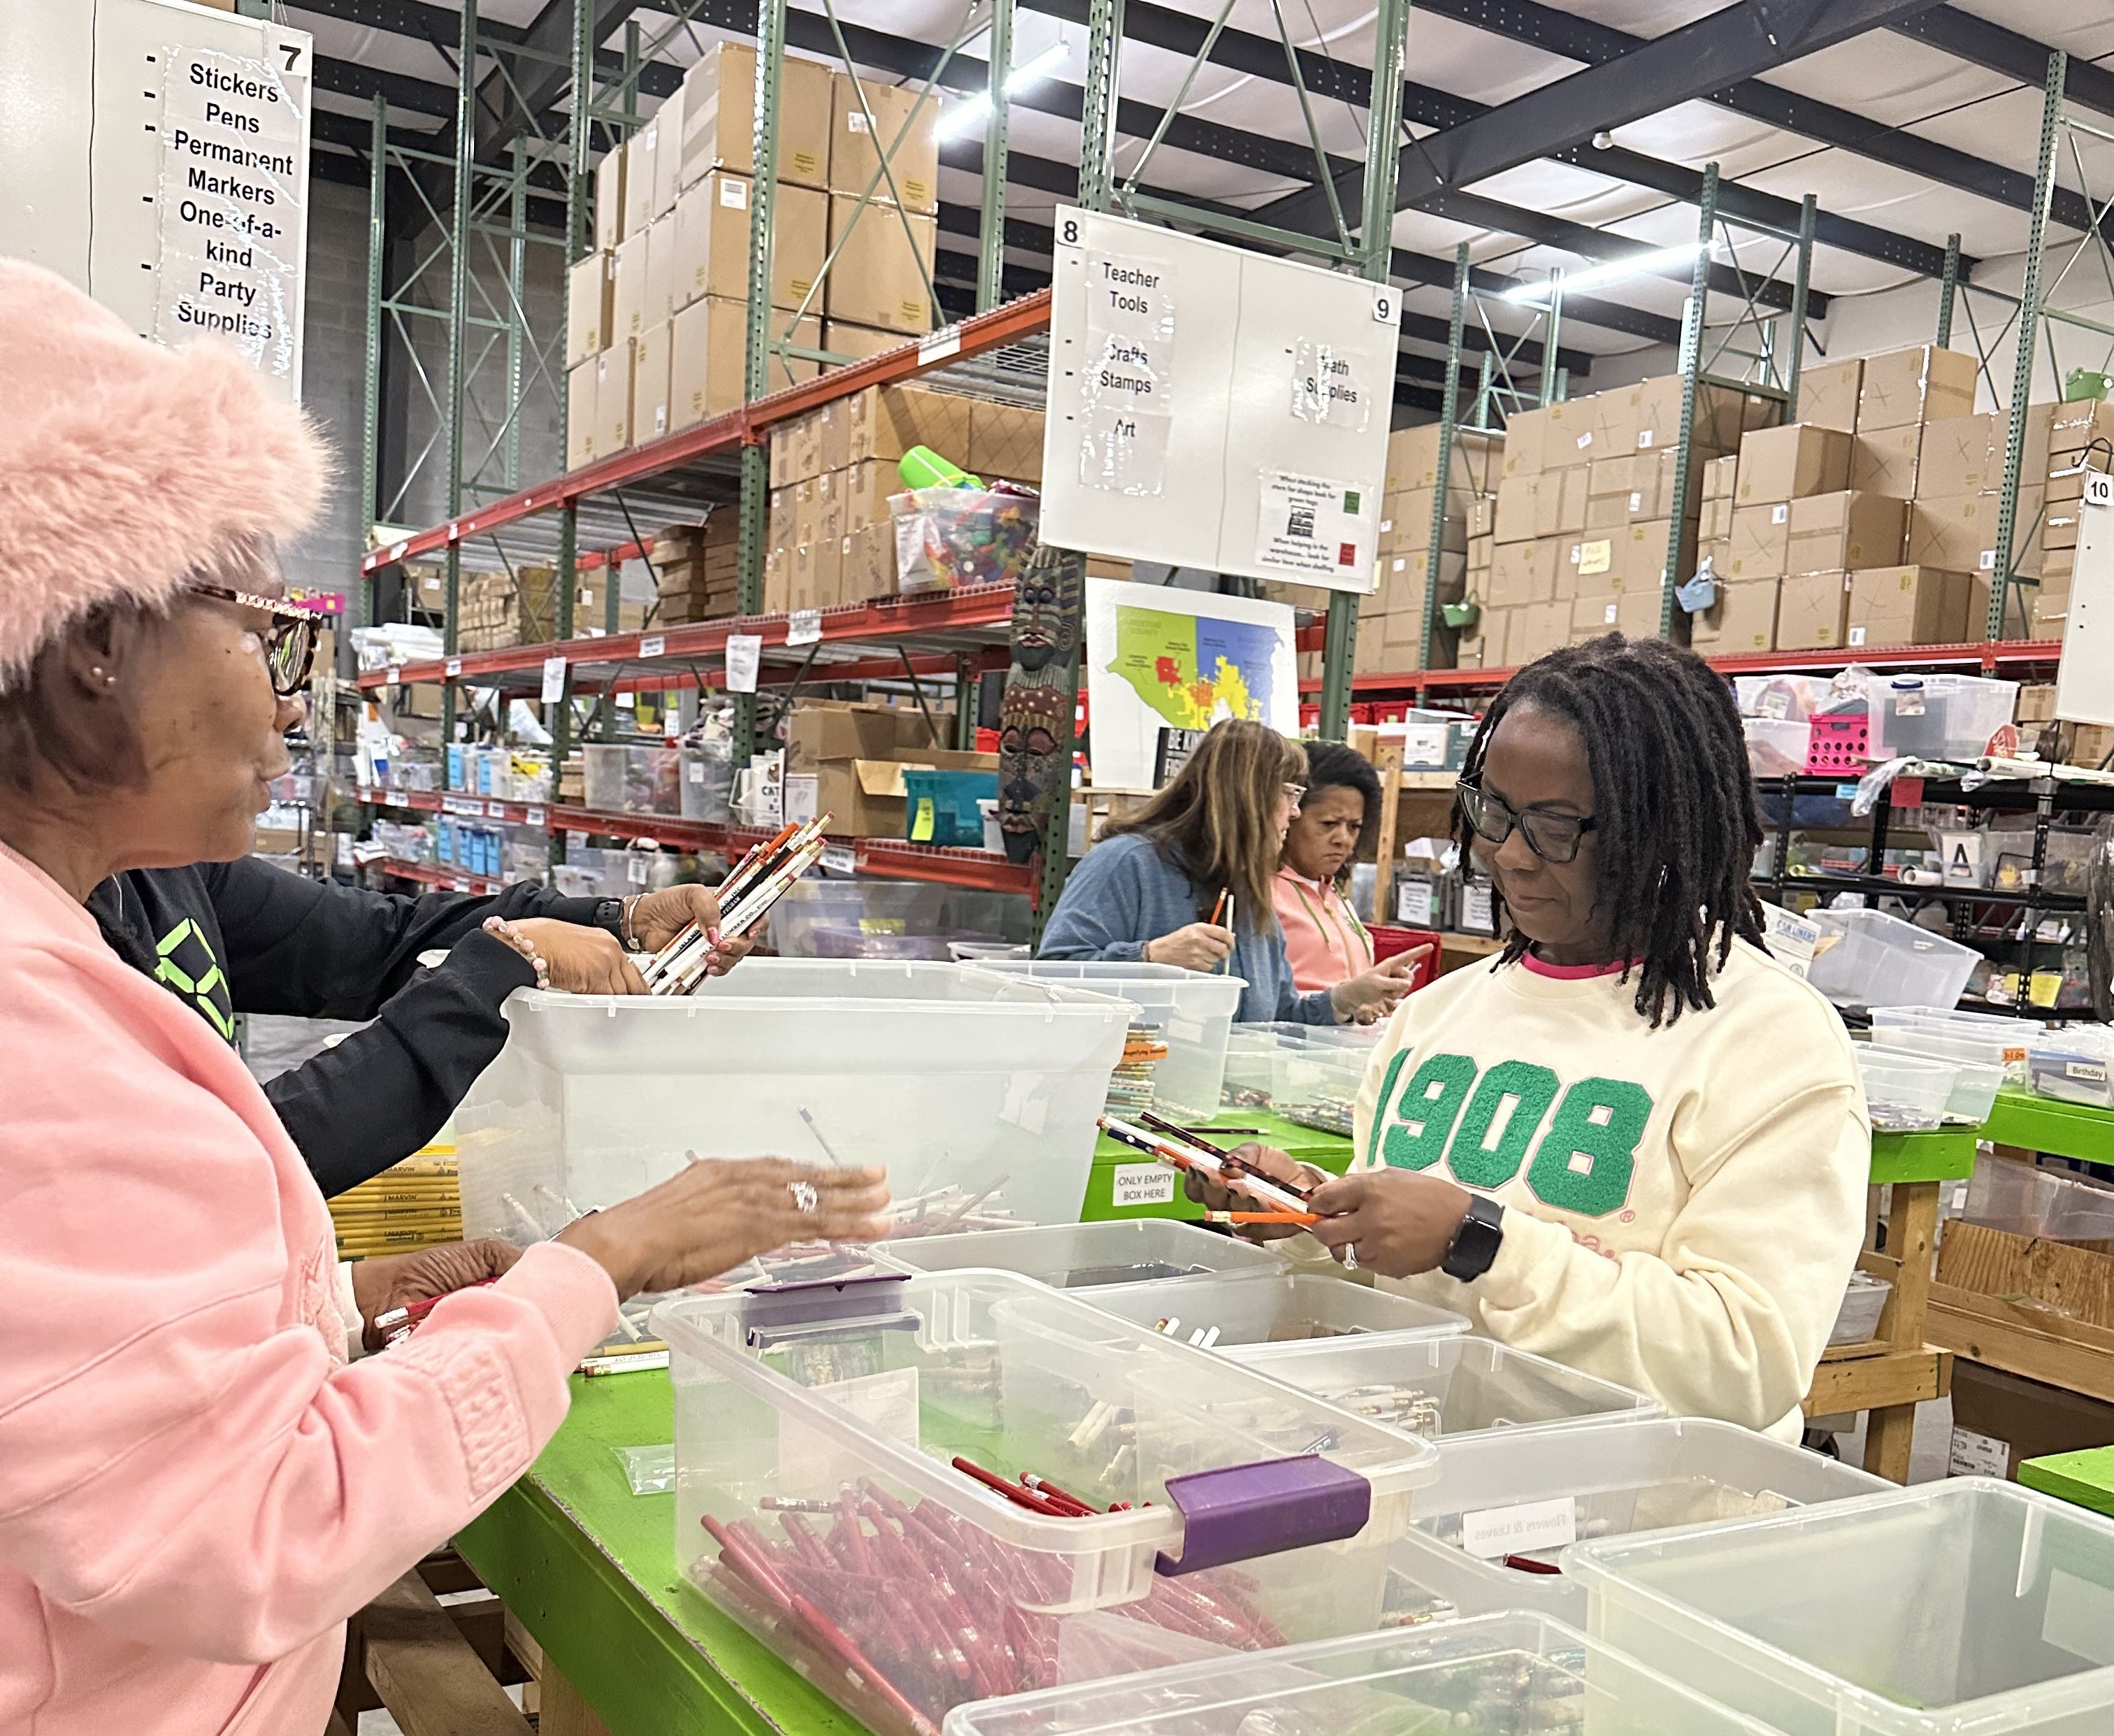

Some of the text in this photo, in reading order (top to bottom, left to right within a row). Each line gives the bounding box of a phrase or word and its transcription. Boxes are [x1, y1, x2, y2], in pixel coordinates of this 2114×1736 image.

[279, 45, 302, 71] 7
[189, 63, 279, 103] Stickers
[206, 102, 260, 134] Pens
[174, 129, 294, 175] Permanent
[188, 168, 275, 205] Markers
[1063, 220, 1078, 243] 8
[206, 239, 252, 268] kind
[1102, 261, 1160, 289] Teacher
[200, 272, 257, 307] Party
[1109, 290, 1149, 314] Tools
[178, 301, 273, 340] Supplies
[1377, 299, 1389, 319] 9
[1320, 355, 1349, 376] ath
[1100, 370, 1152, 396] Stamps
[1306, 377, 1358, 403] Splies
[1114, 419, 1136, 438] Art
[2091, 481, 2108, 498] 10
[1949, 842, 1972, 877] A
[2072, 1066, 2104, 1080] Birthday
[1367, 1047, 1655, 1218] 1908
[1119, 1174, 1172, 1186] ONLY EMPTY
[1123, 1189, 1165, 1200] BOX HERE
